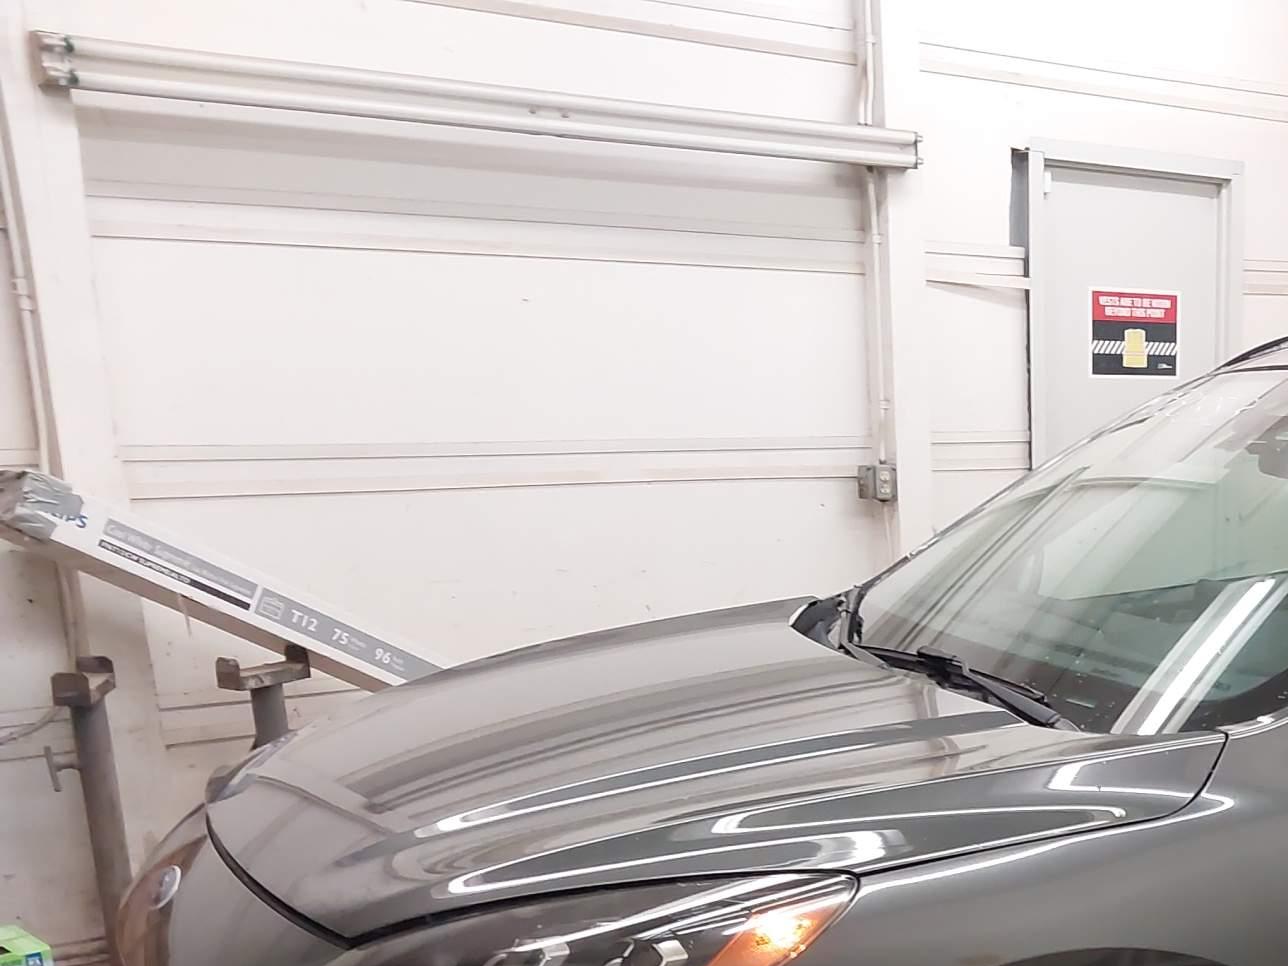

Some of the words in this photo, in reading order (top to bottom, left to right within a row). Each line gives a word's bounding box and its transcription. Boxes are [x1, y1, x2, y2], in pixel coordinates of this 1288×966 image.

[291, 609, 318, 632] T12
[331, 628, 350, 645] 75
[374, 648, 391, 665] 96
